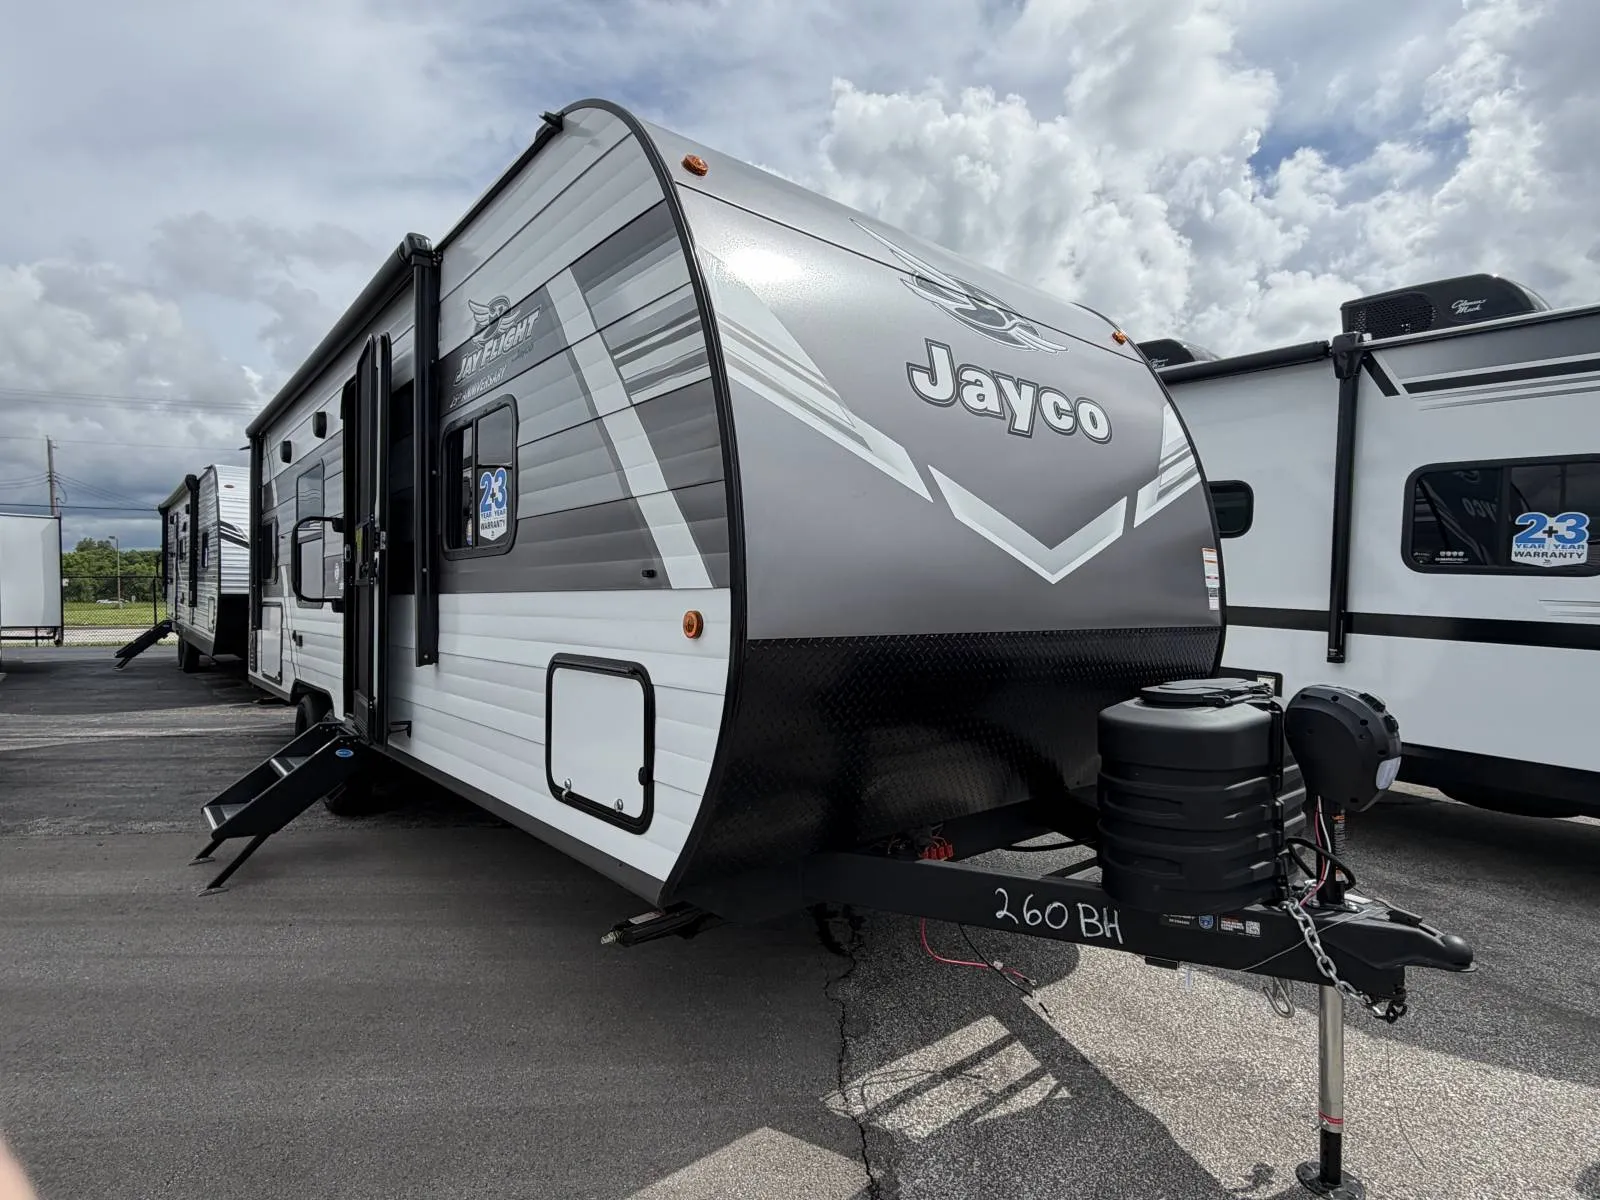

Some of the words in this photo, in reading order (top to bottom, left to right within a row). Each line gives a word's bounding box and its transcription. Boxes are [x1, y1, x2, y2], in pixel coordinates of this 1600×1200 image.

[454, 349, 483, 385] JAY
[481, 307, 541, 369] FLIGHT
[906, 338, 1113, 444] Jayco
[480, 520, 505, 531] WARRANTY
[1514, 512, 1589, 544] 2+3
[1513, 551, 1585, 559] WARRANTY
[995, 887, 1068, 929] 260
[1077, 902, 1123, 944] BH
